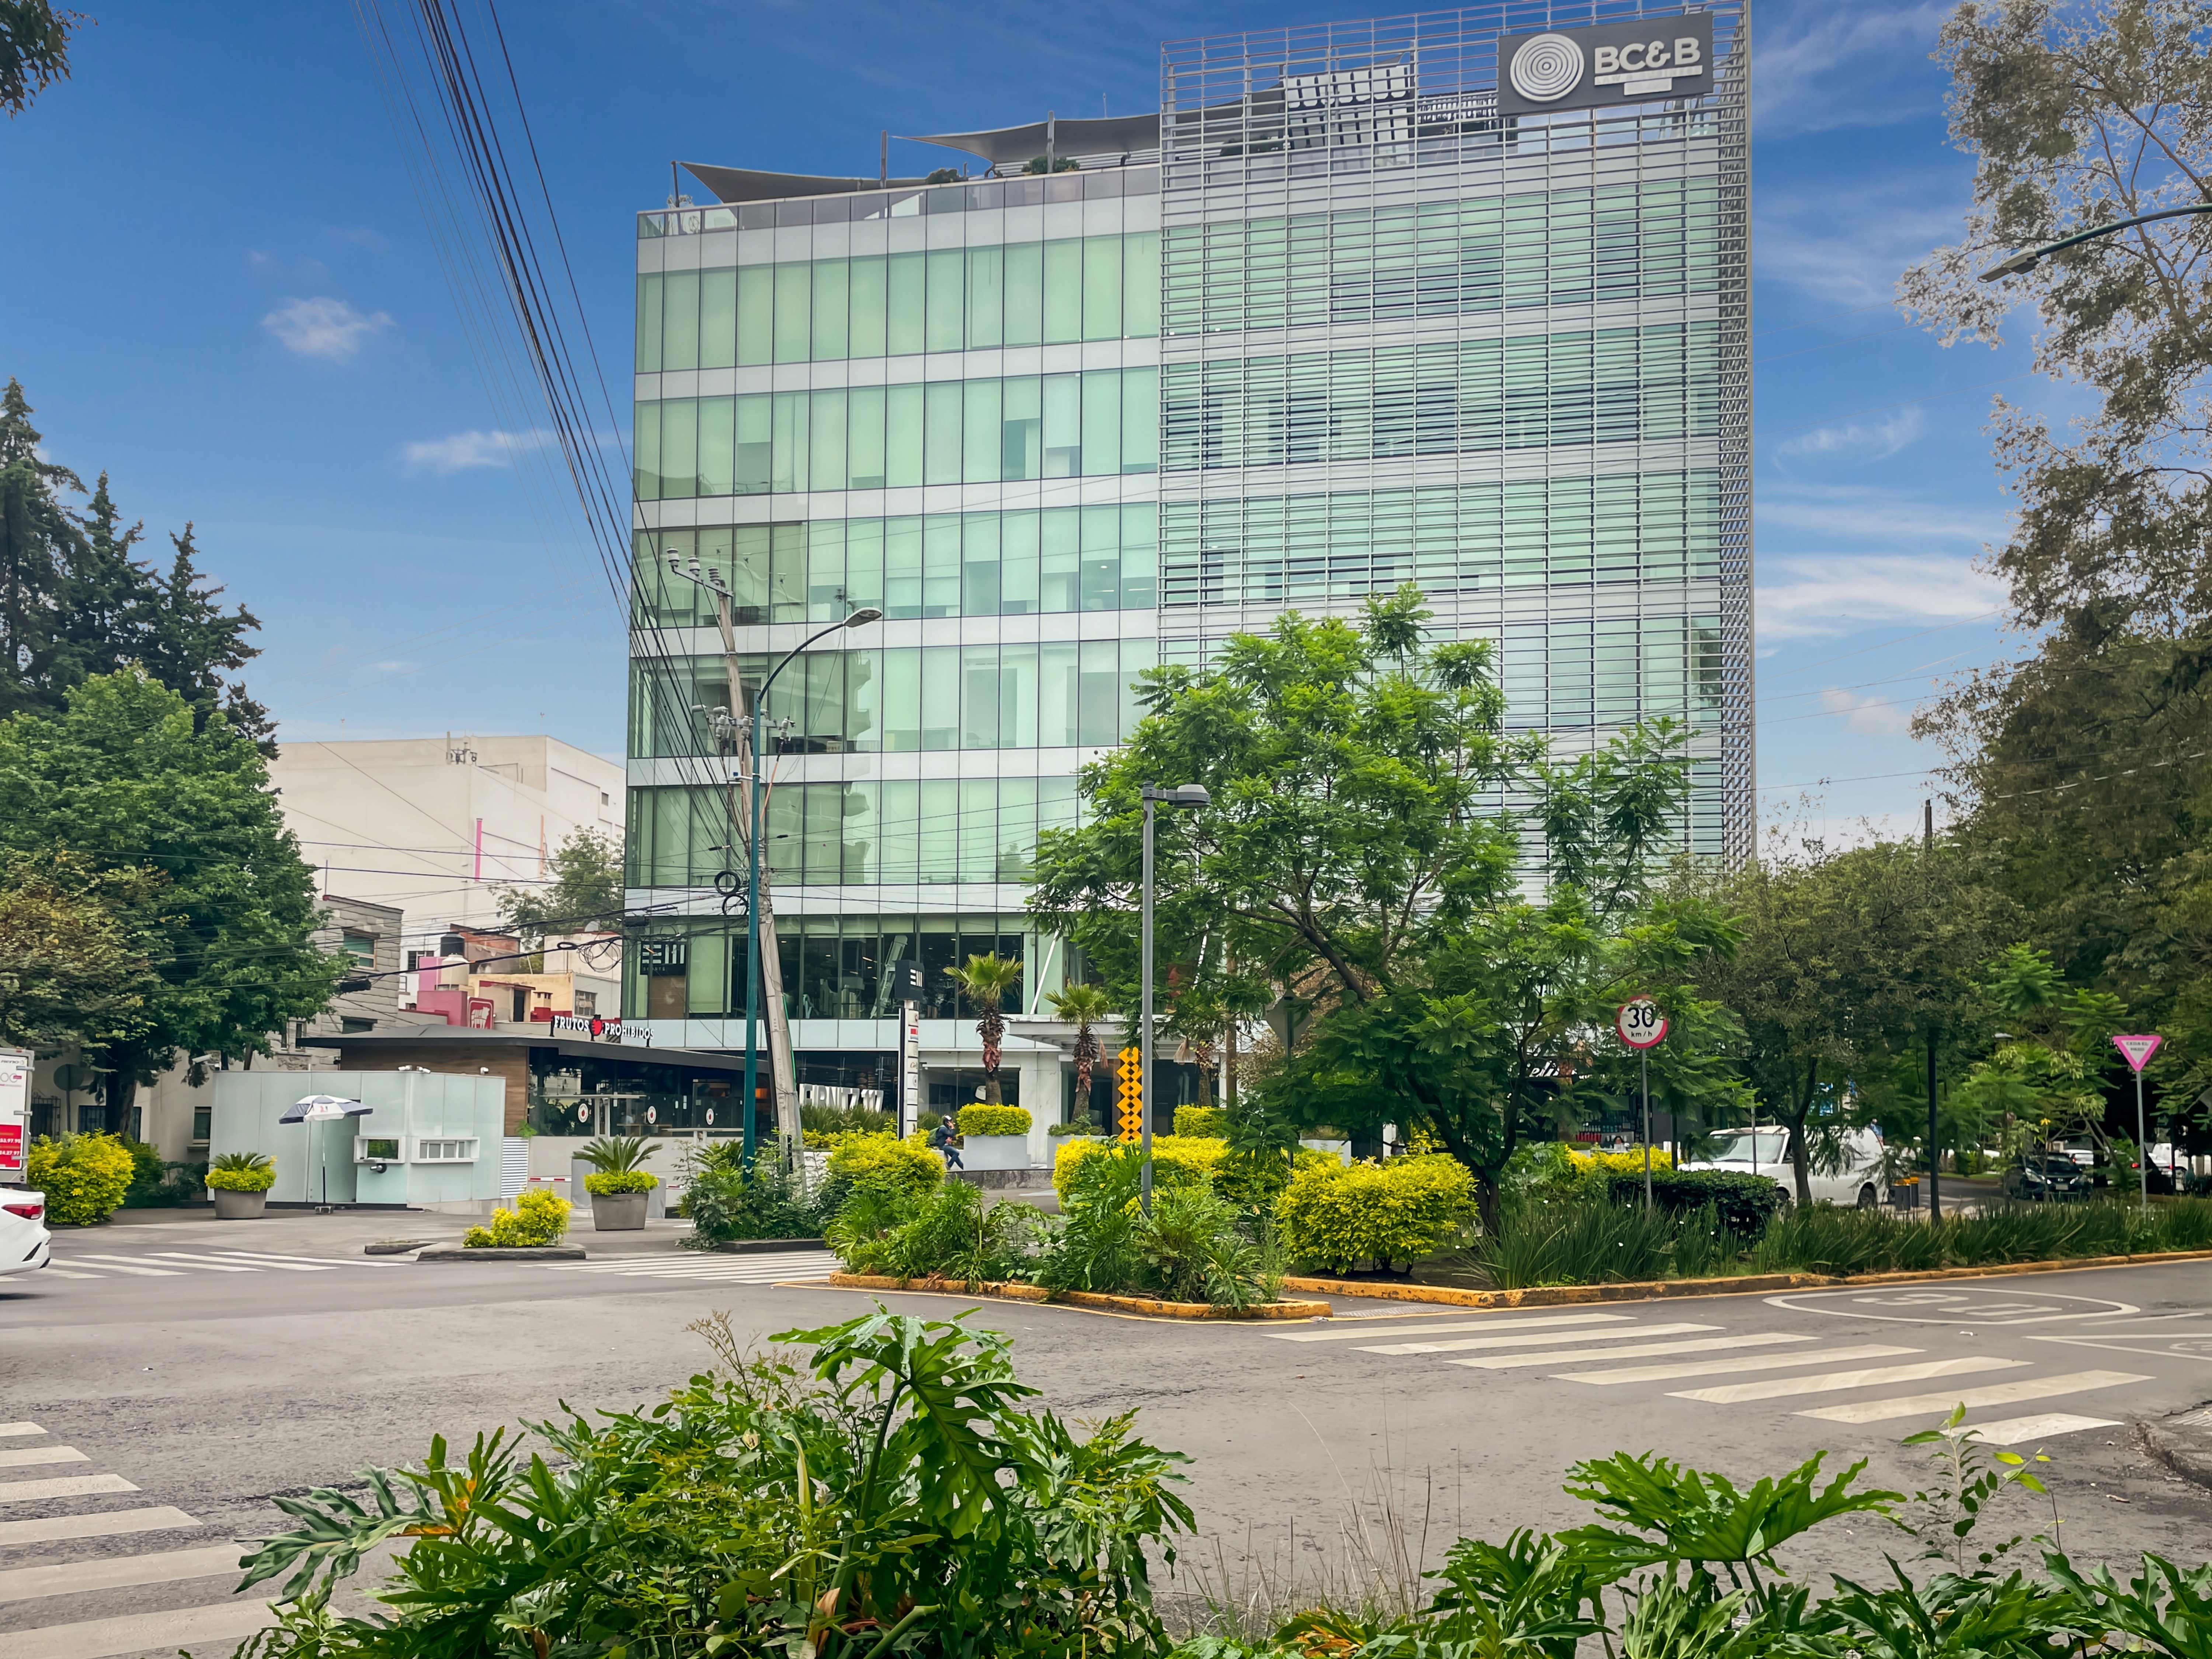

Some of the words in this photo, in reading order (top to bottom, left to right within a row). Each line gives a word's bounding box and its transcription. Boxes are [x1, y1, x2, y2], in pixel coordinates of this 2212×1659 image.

[1594, 37, 1701, 74] BC&B
[554, 1015, 589, 1032] FRUTOS
[604, 1022, 654, 1039] PROHIBIDOS
[1628, 1007, 1655, 1028] 30
